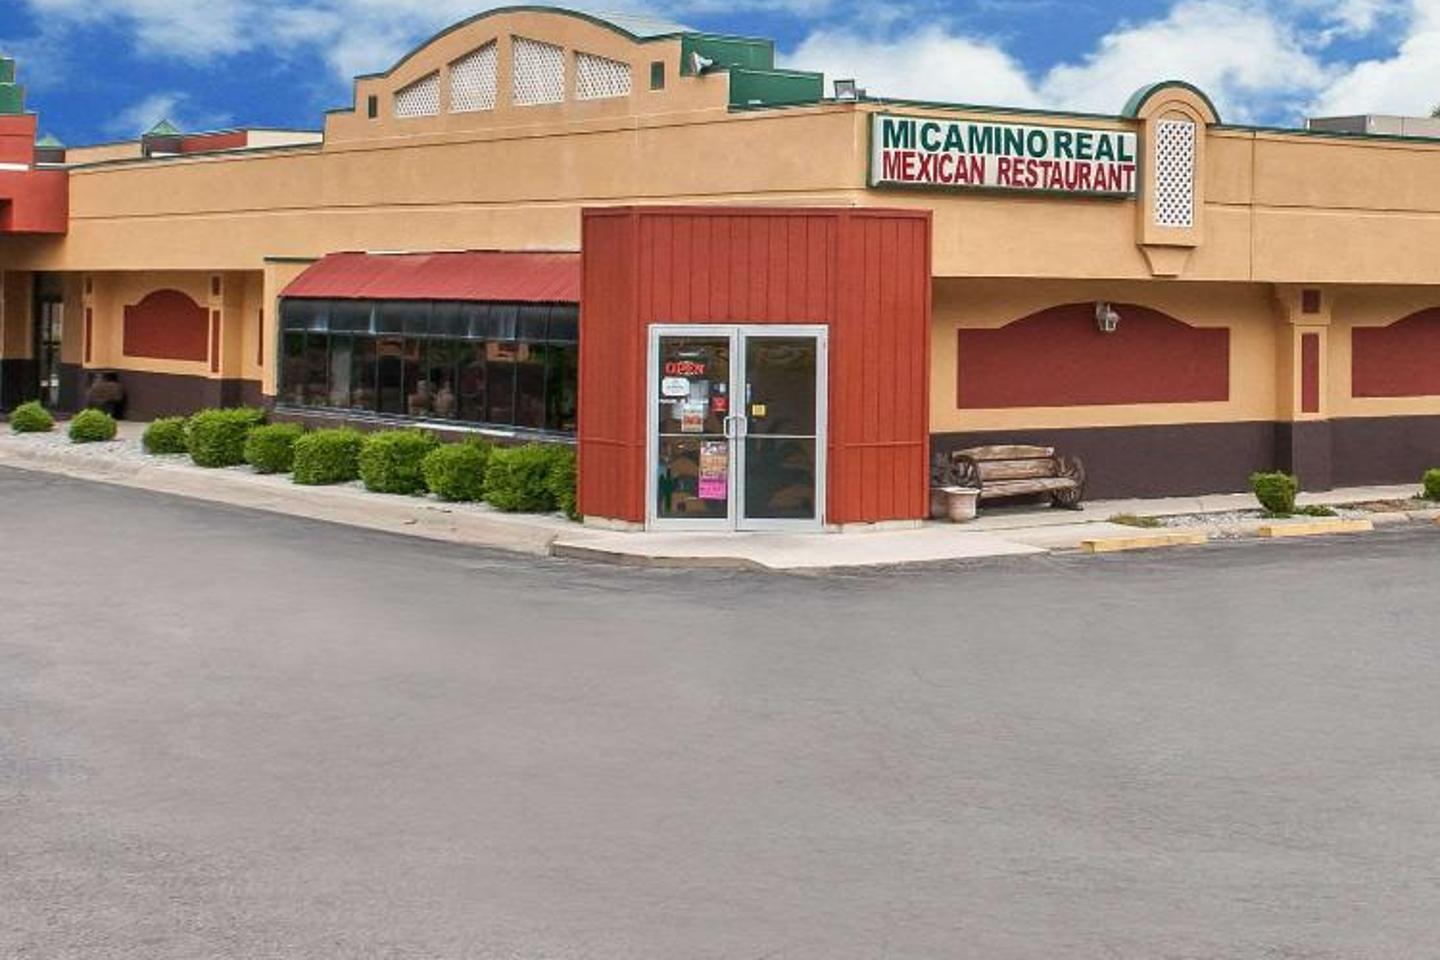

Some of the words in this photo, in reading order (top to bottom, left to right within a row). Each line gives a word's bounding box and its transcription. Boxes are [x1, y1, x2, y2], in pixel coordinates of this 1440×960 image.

[1054, 132, 1133, 162] REAL
[883, 151, 985, 185] MEXICAN
[999, 157, 1135, 191] RESTAURANT
[666, 362, 704, 375] OPEN
